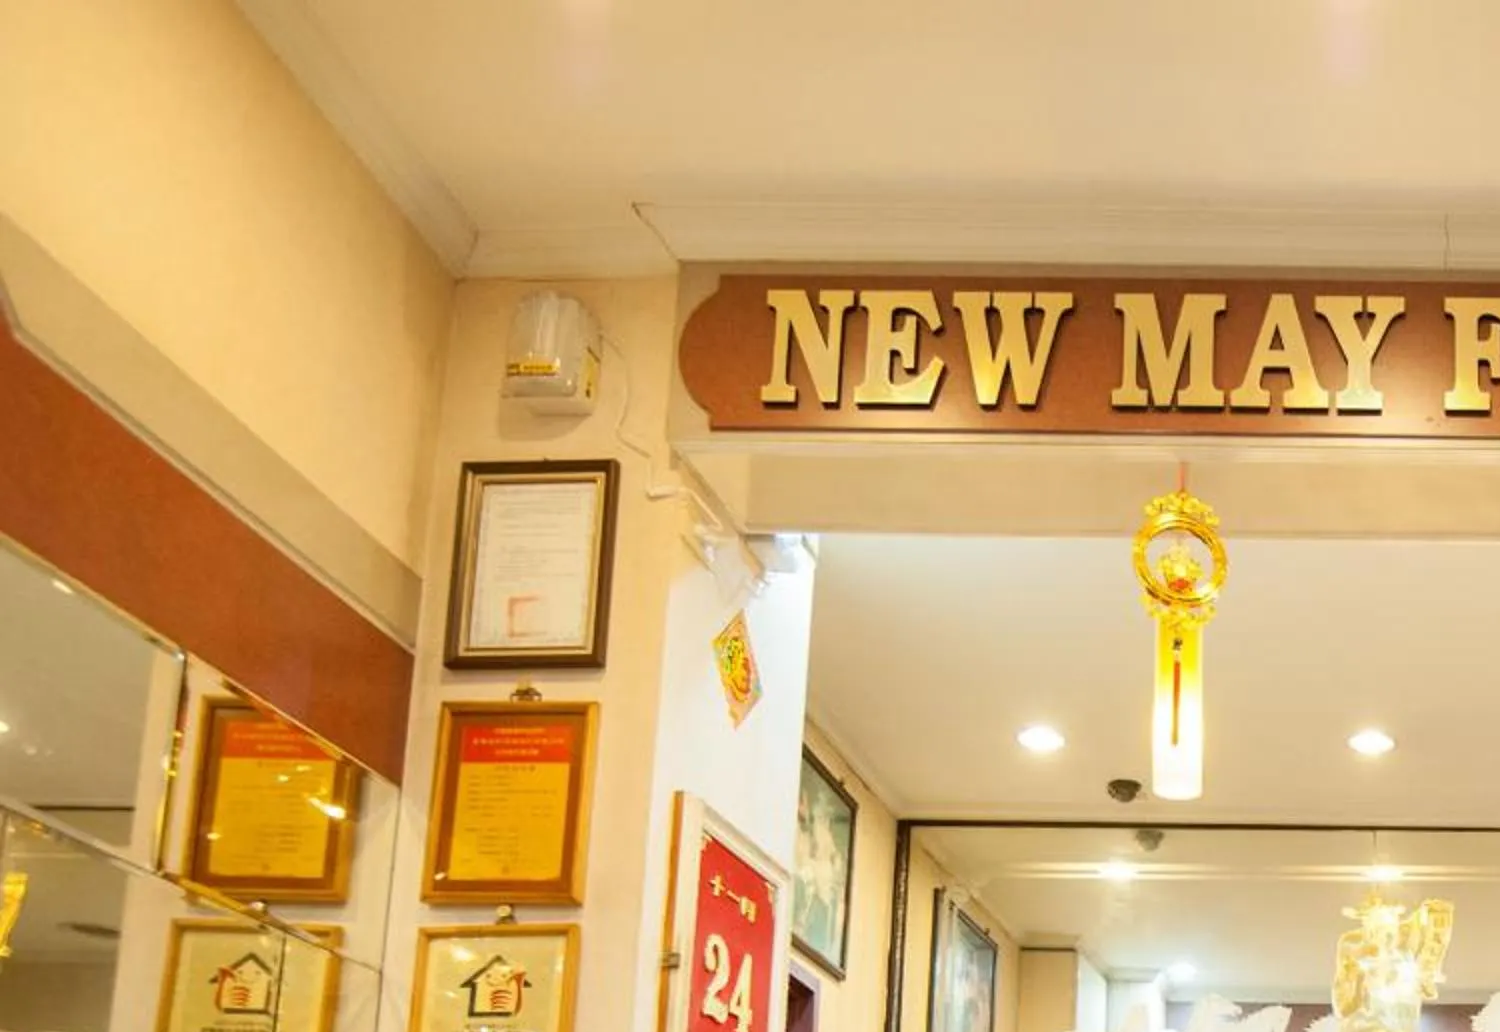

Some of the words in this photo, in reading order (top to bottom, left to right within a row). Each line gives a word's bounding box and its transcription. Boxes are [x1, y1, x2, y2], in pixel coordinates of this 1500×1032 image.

[761, 289, 1073, 408] NEW
[1110, 292, 1406, 412] MAY
[708, 874, 757, 923] 十一月
